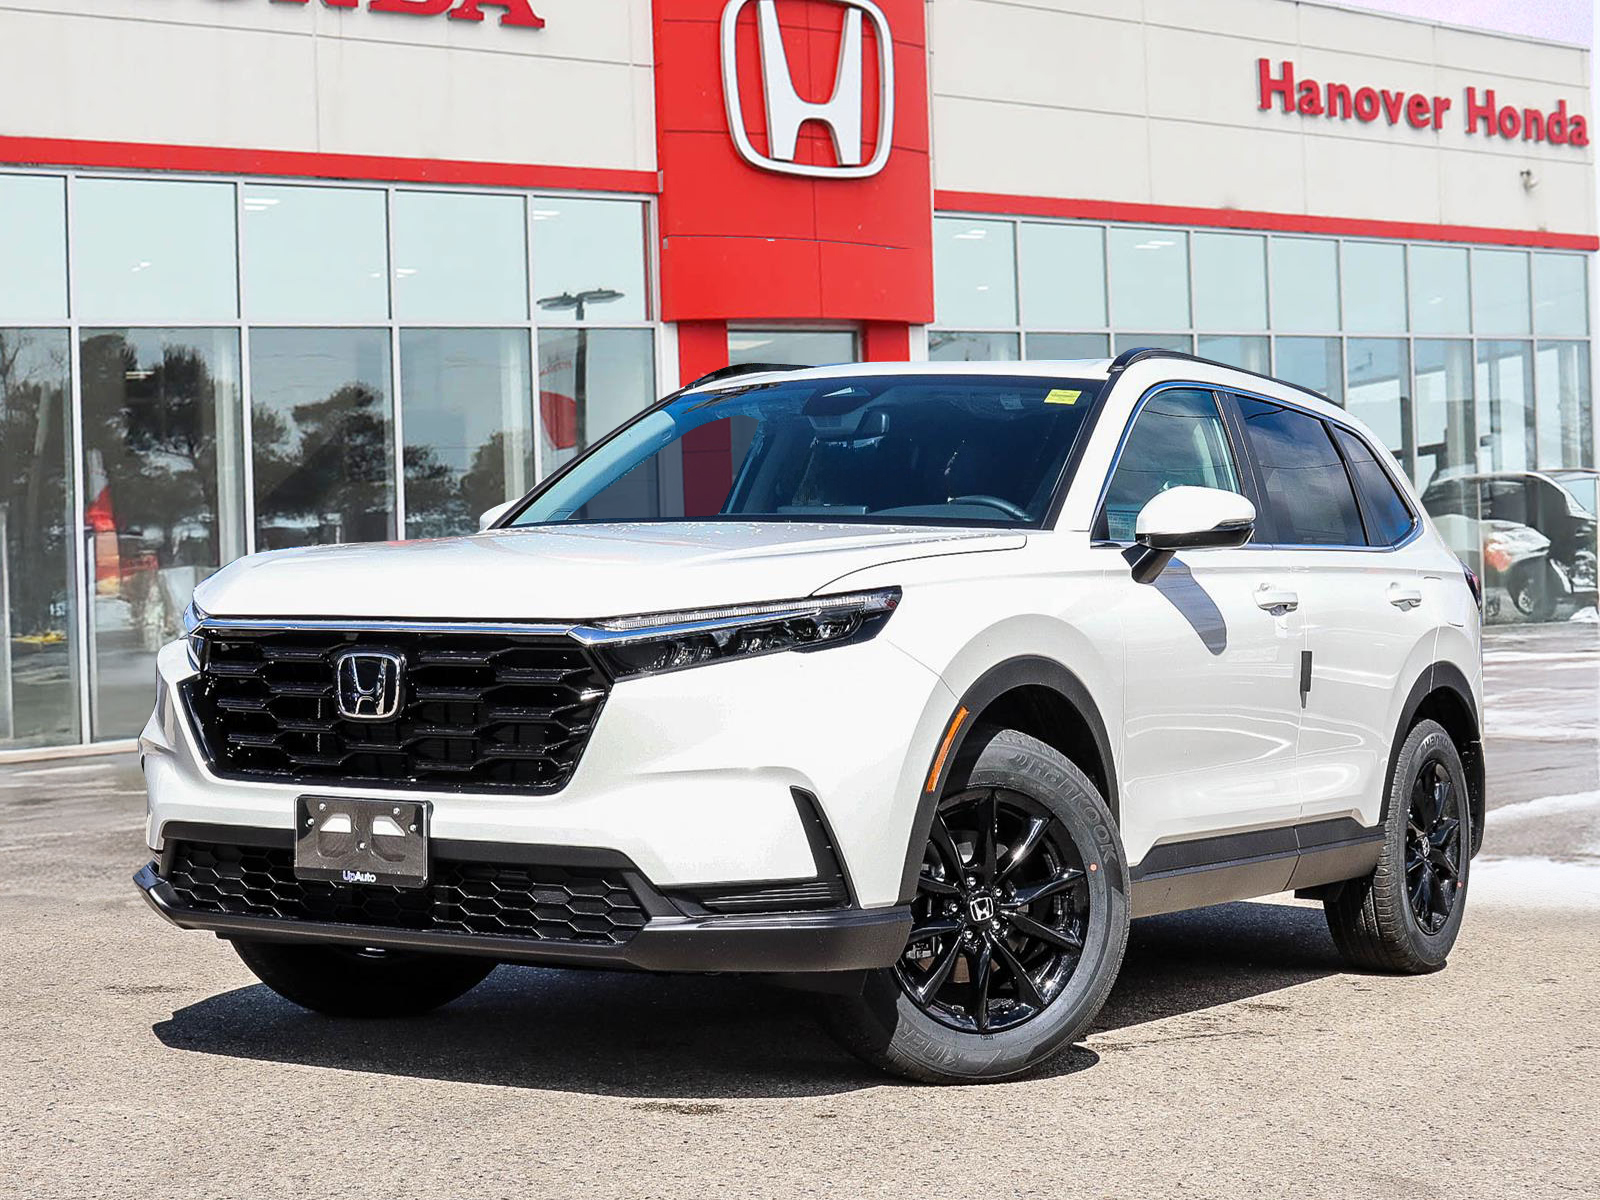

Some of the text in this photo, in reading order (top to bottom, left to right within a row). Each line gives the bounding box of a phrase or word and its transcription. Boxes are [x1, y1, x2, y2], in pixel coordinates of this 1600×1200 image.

[1258, 58, 1590, 148] Hanover Honda
[342, 870, 377, 883] UpAuto
